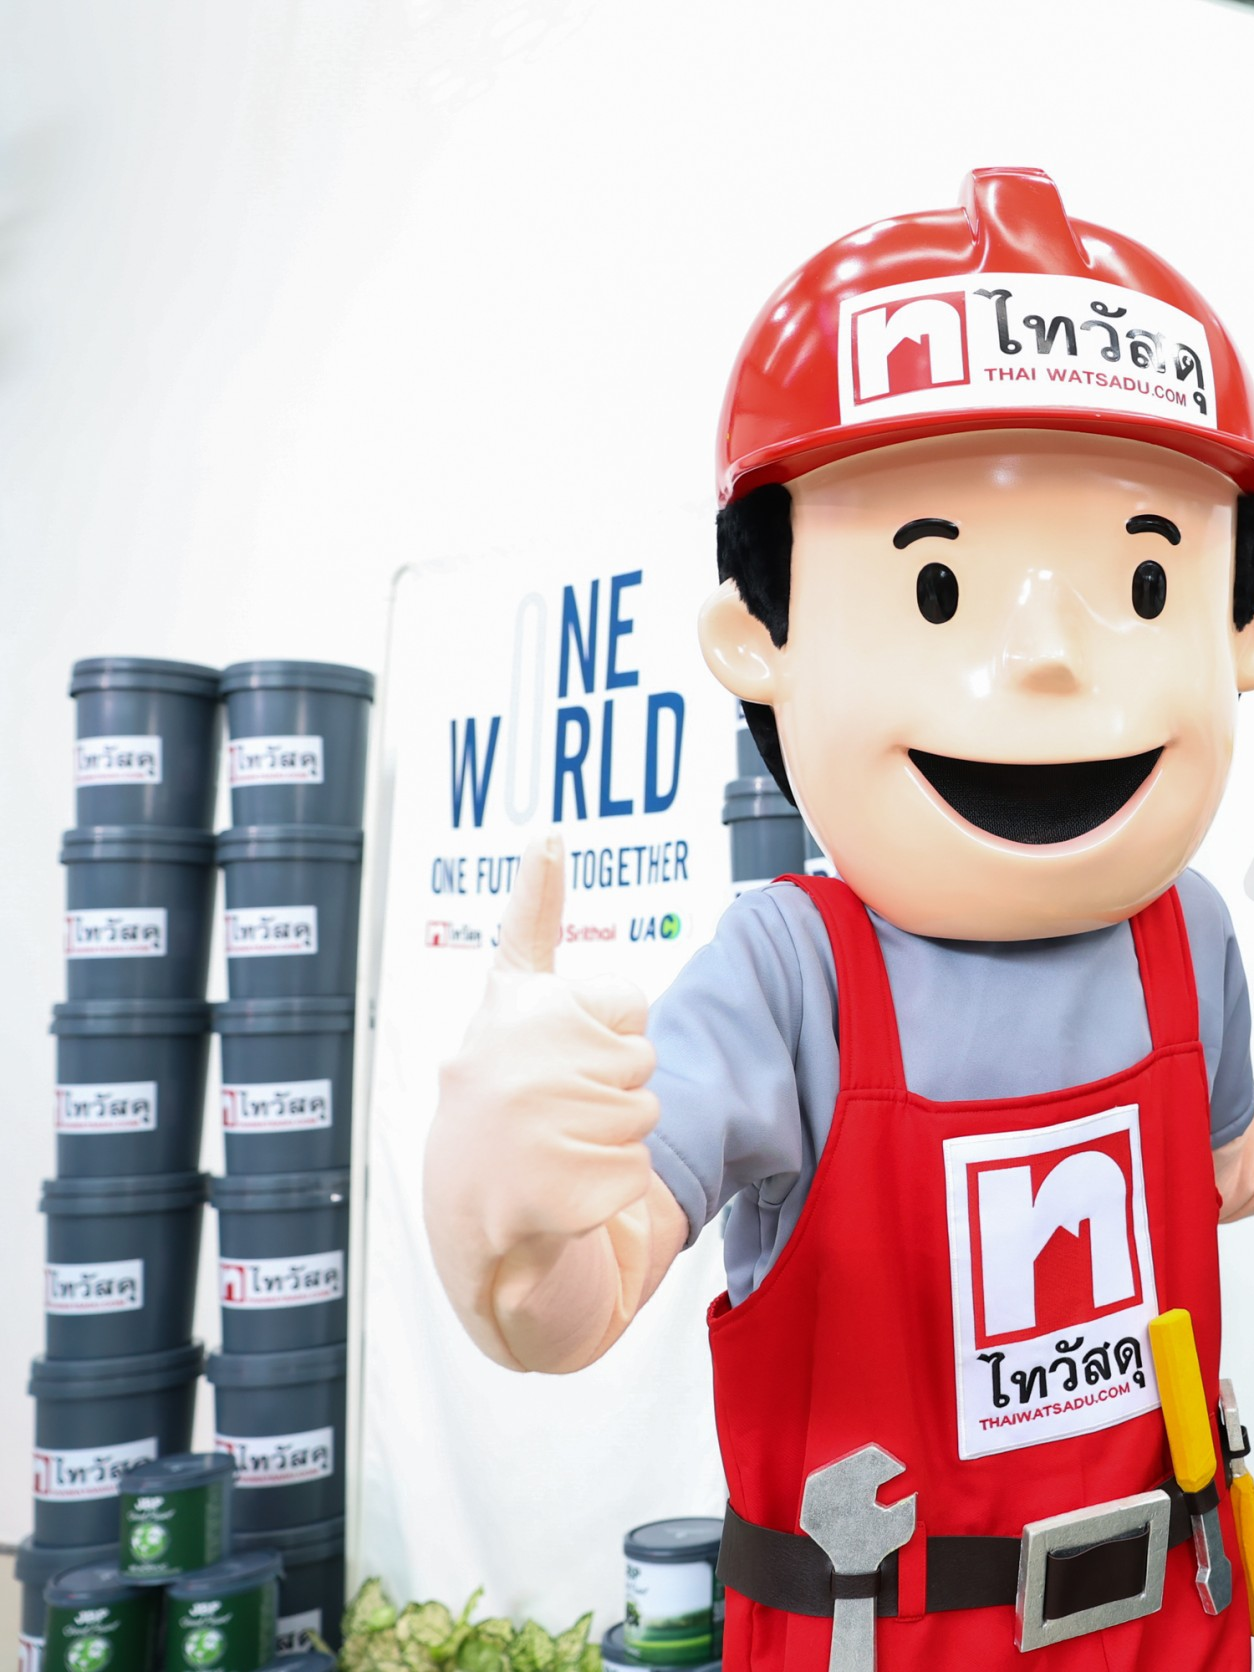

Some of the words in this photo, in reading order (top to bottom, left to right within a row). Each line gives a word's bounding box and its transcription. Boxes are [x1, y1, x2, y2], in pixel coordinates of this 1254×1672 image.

[973, 288, 1207, 416] ไทวัสดุ
[984, 367, 1036, 381] THAI
[1046, 368, 1187, 407] WATSADU.COM
[451, 691, 686, 829] WORLD
[431, 857, 467, 895] ONE
[477, 856, 520, 895] FUT
[571, 840, 689, 889] TOGETHER
[630, 914, 674, 942] UAC
[977, 1336, 1146, 1408] ไทวัสดุ
[979, 1382, 1131, 1431] THAIWATSADU.COM
